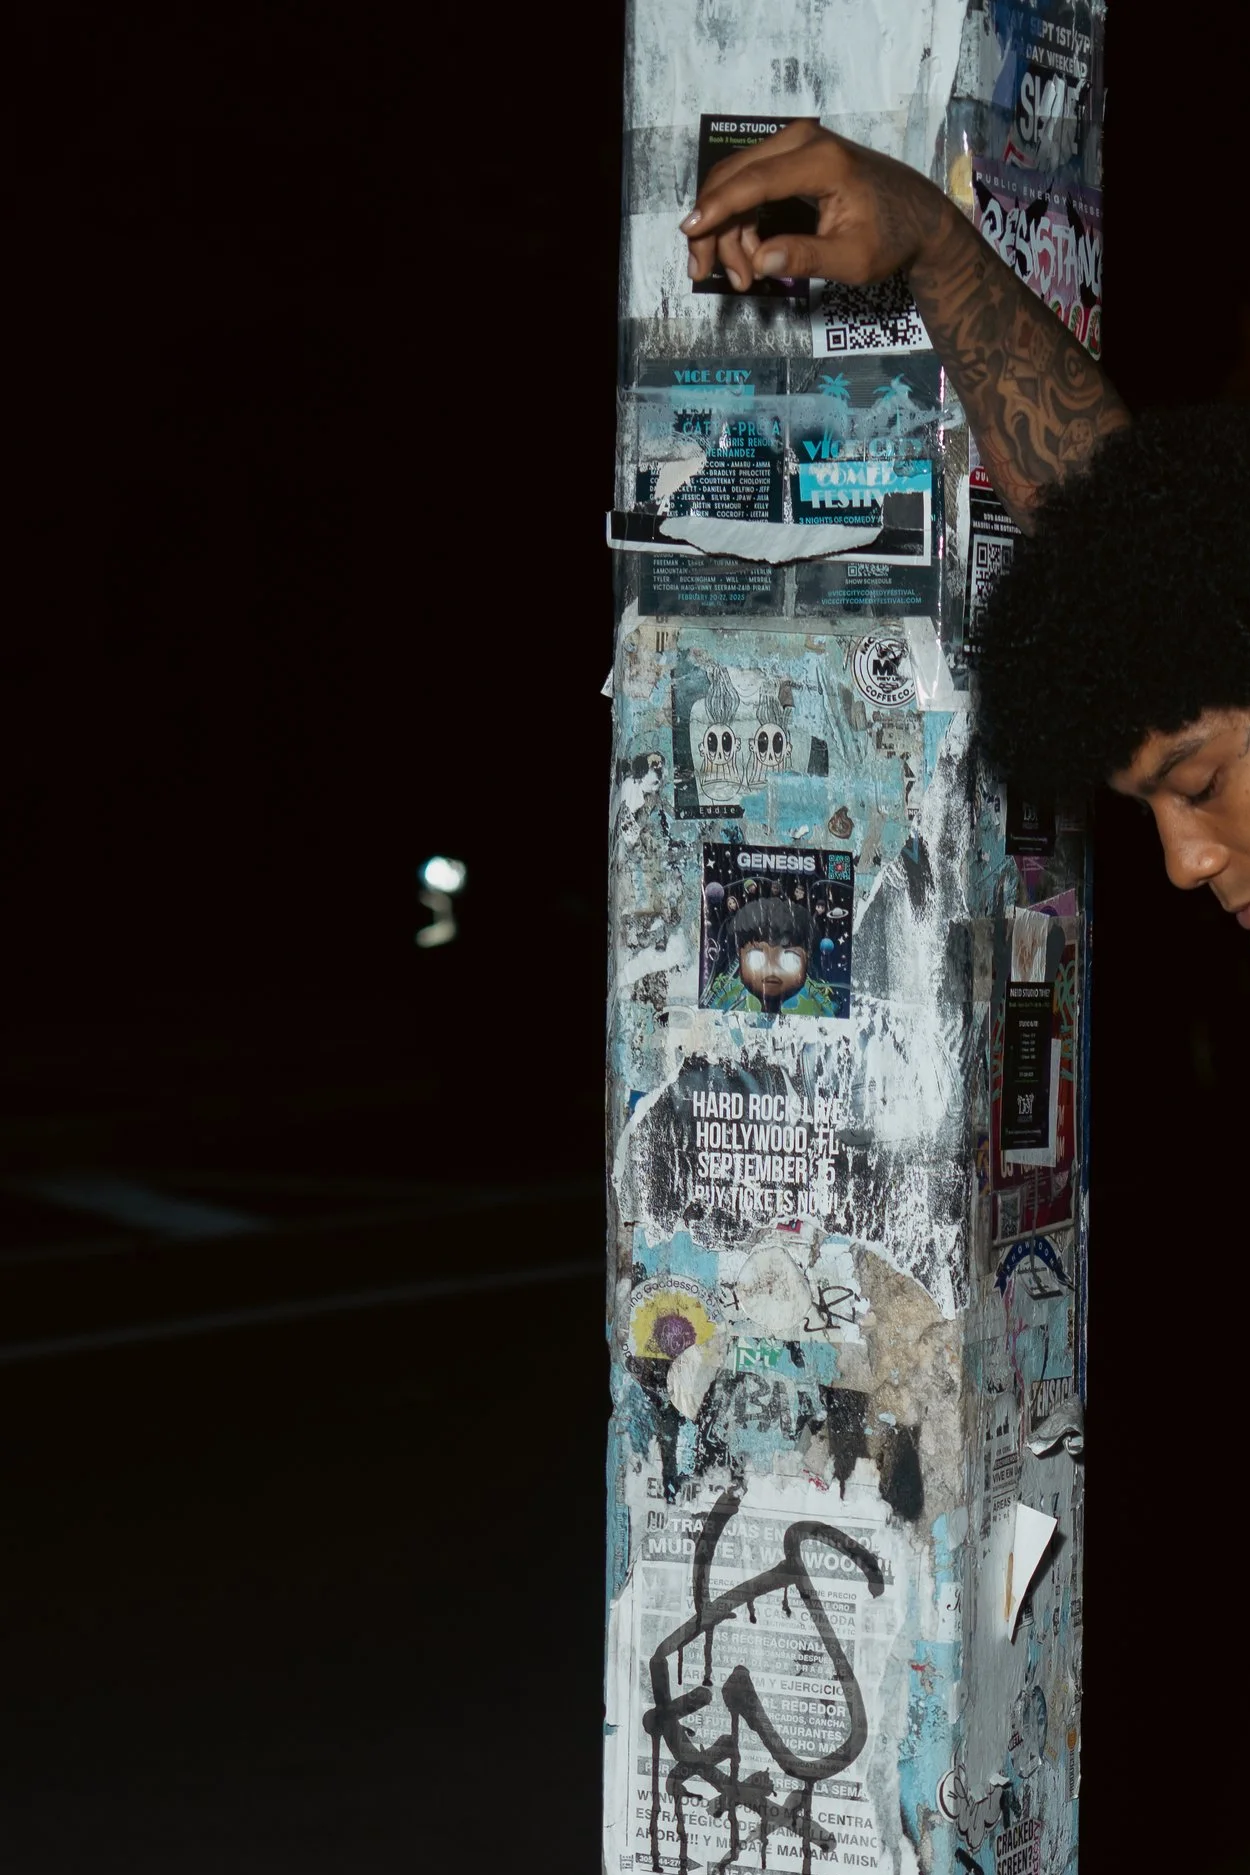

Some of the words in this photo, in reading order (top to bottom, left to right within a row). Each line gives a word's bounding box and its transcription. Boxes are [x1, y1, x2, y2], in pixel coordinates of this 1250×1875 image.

[711, 122, 737, 132] NEED
[740, 122, 777, 134] STUDIO
[976, 171, 1017, 193] PUBLIC
[674, 370, 710, 383] VICE
[715, 370, 752, 383] CITY
[706, 448, 755, 458] HERNANDEZ
[866, 685, 897, 702] COFFEE
[737, 852, 816, 873] GENESIS
[693, 1091, 743, 1119] HARD
[749, 1094, 795, 1121] ROCK
[697, 1152, 807, 1184] SEPTEMBER
[730, 1186, 794, 1213] TICKETS
[827, 1591, 857, 1600] PRECIO
[781, 1700, 846, 1717] REDEDOR
[996, 1819, 1034, 1858] CRACKED
